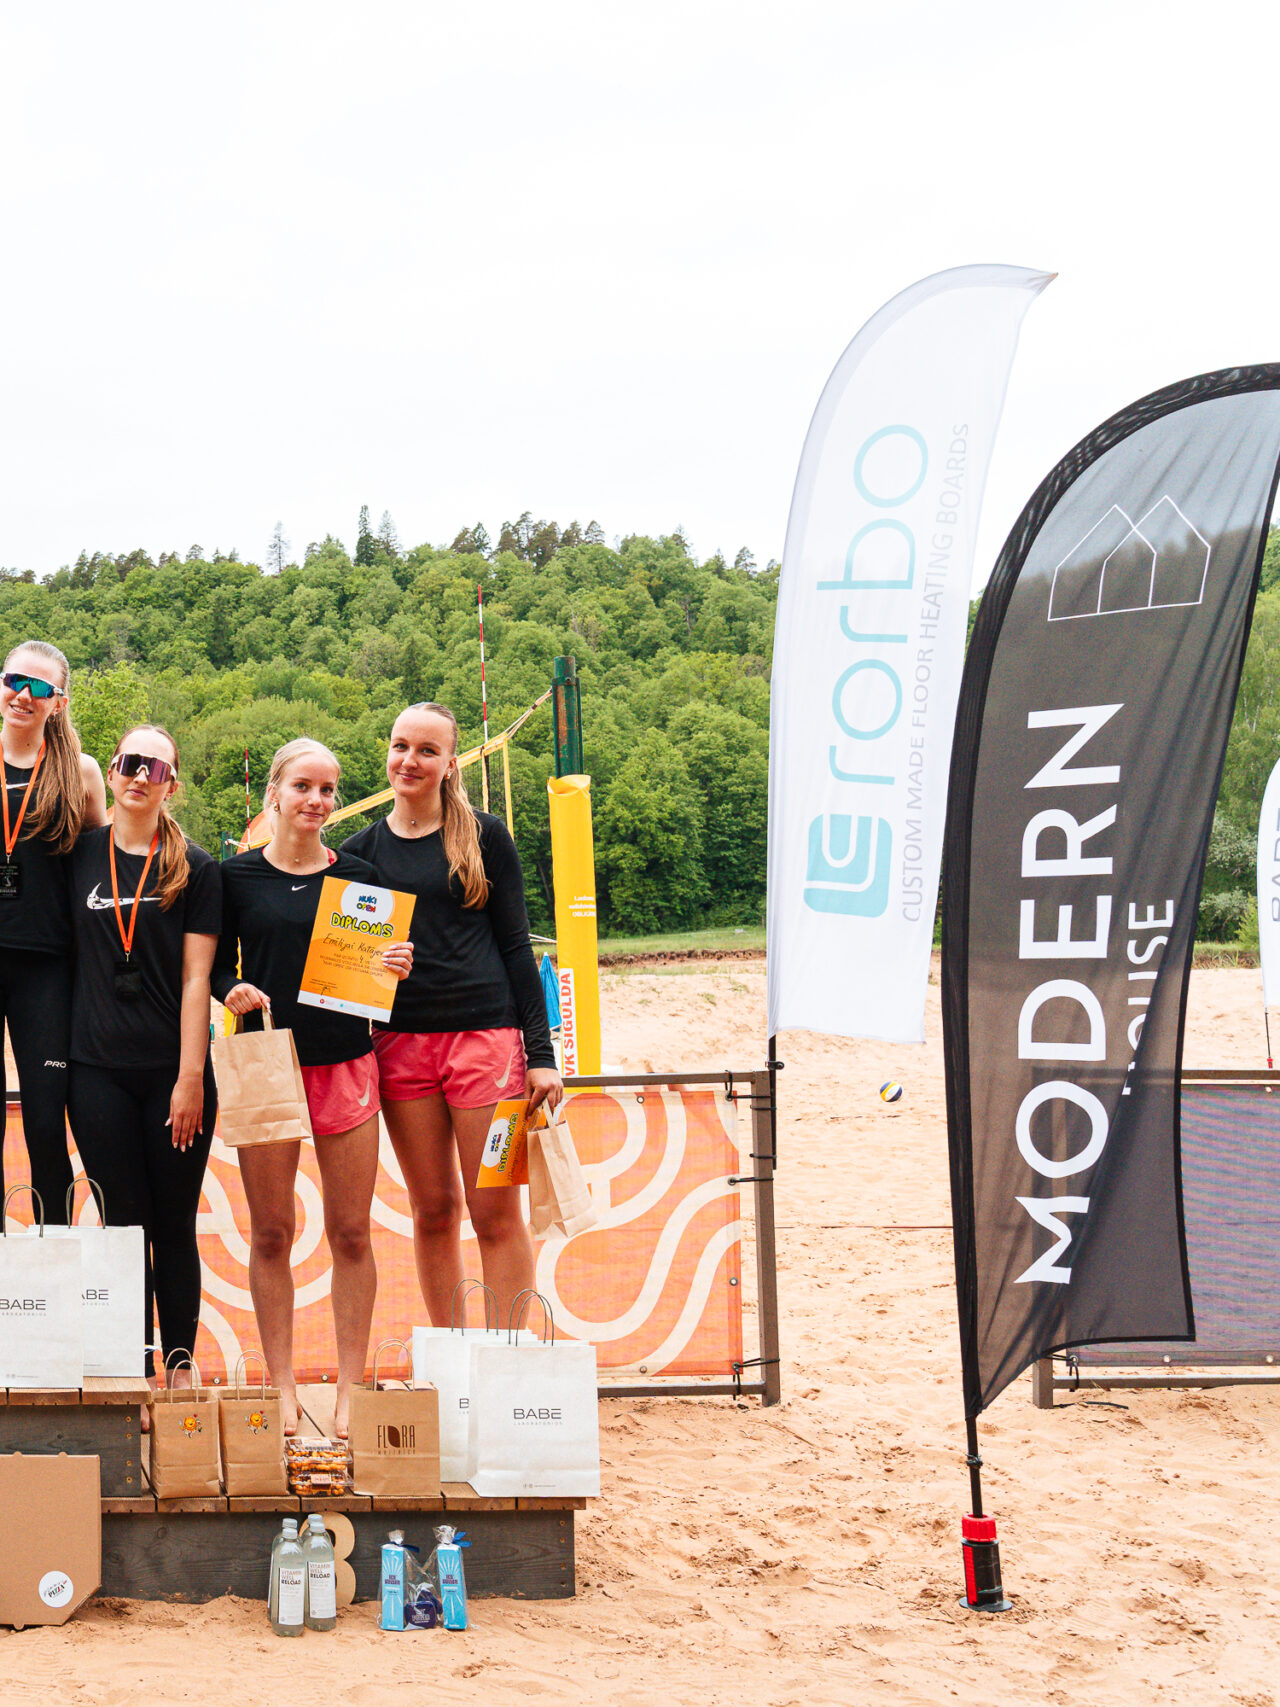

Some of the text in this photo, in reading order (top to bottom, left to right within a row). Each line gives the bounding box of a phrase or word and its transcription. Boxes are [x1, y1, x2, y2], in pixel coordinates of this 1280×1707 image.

[902, 422, 970, 922] CUSTOM MADE FLOOR HEATING BOARDS
[356, 902, 376, 912] OPEN
[358, 895, 377, 905] NUKI
[331, 912, 394, 938] DIPLOMS
[1013, 703, 1125, 1284] MODERN
[560, 972, 576, 1077] VK SIGULDA
[43, 1060, 67, 1069] PRO
[497, 1112, 519, 1173] DIPLOMS
[81, 1289, 109, 1300] BE
[513, 1408, 562, 1420] BABE
